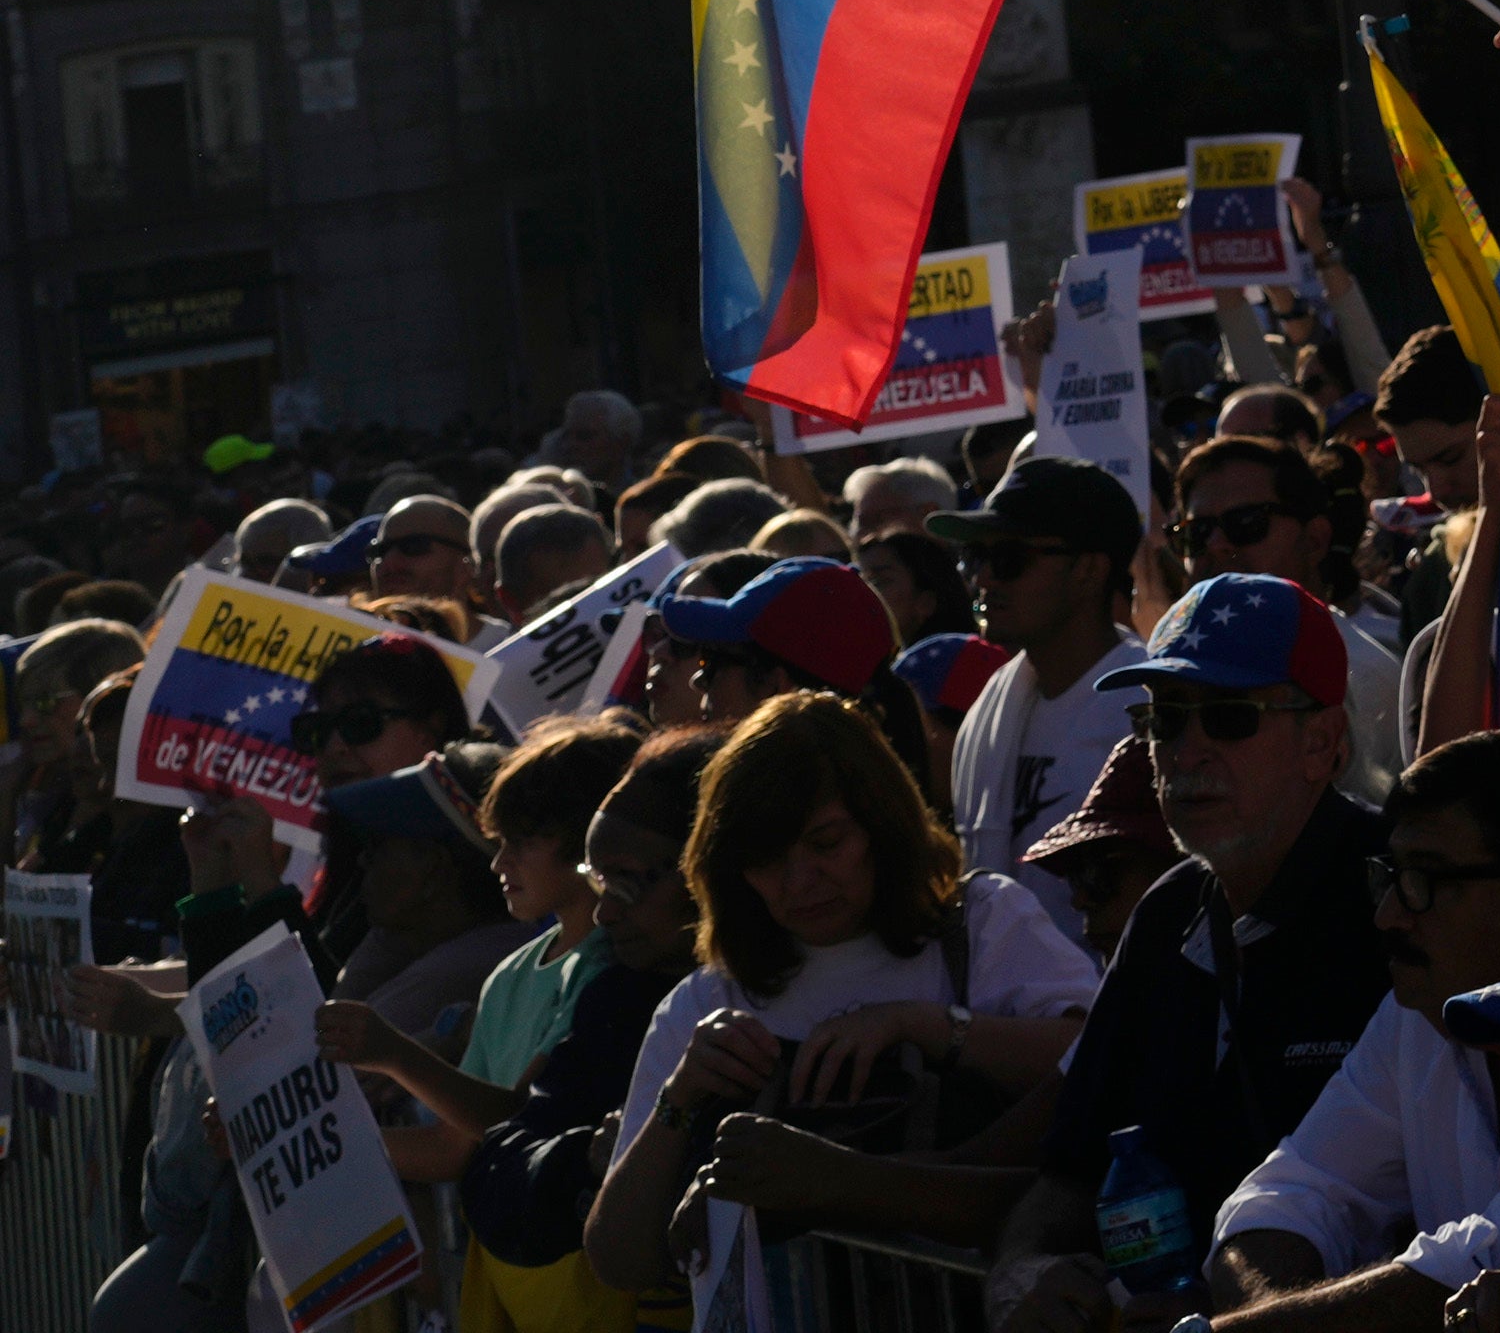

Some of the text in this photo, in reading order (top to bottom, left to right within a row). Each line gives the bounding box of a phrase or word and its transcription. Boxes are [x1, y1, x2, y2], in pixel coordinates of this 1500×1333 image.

[201, 600, 255, 650] Por
[258, 613, 290, 660] la
[155, 736, 187, 773] de
[252, 1112, 345, 1218] TE VAS
